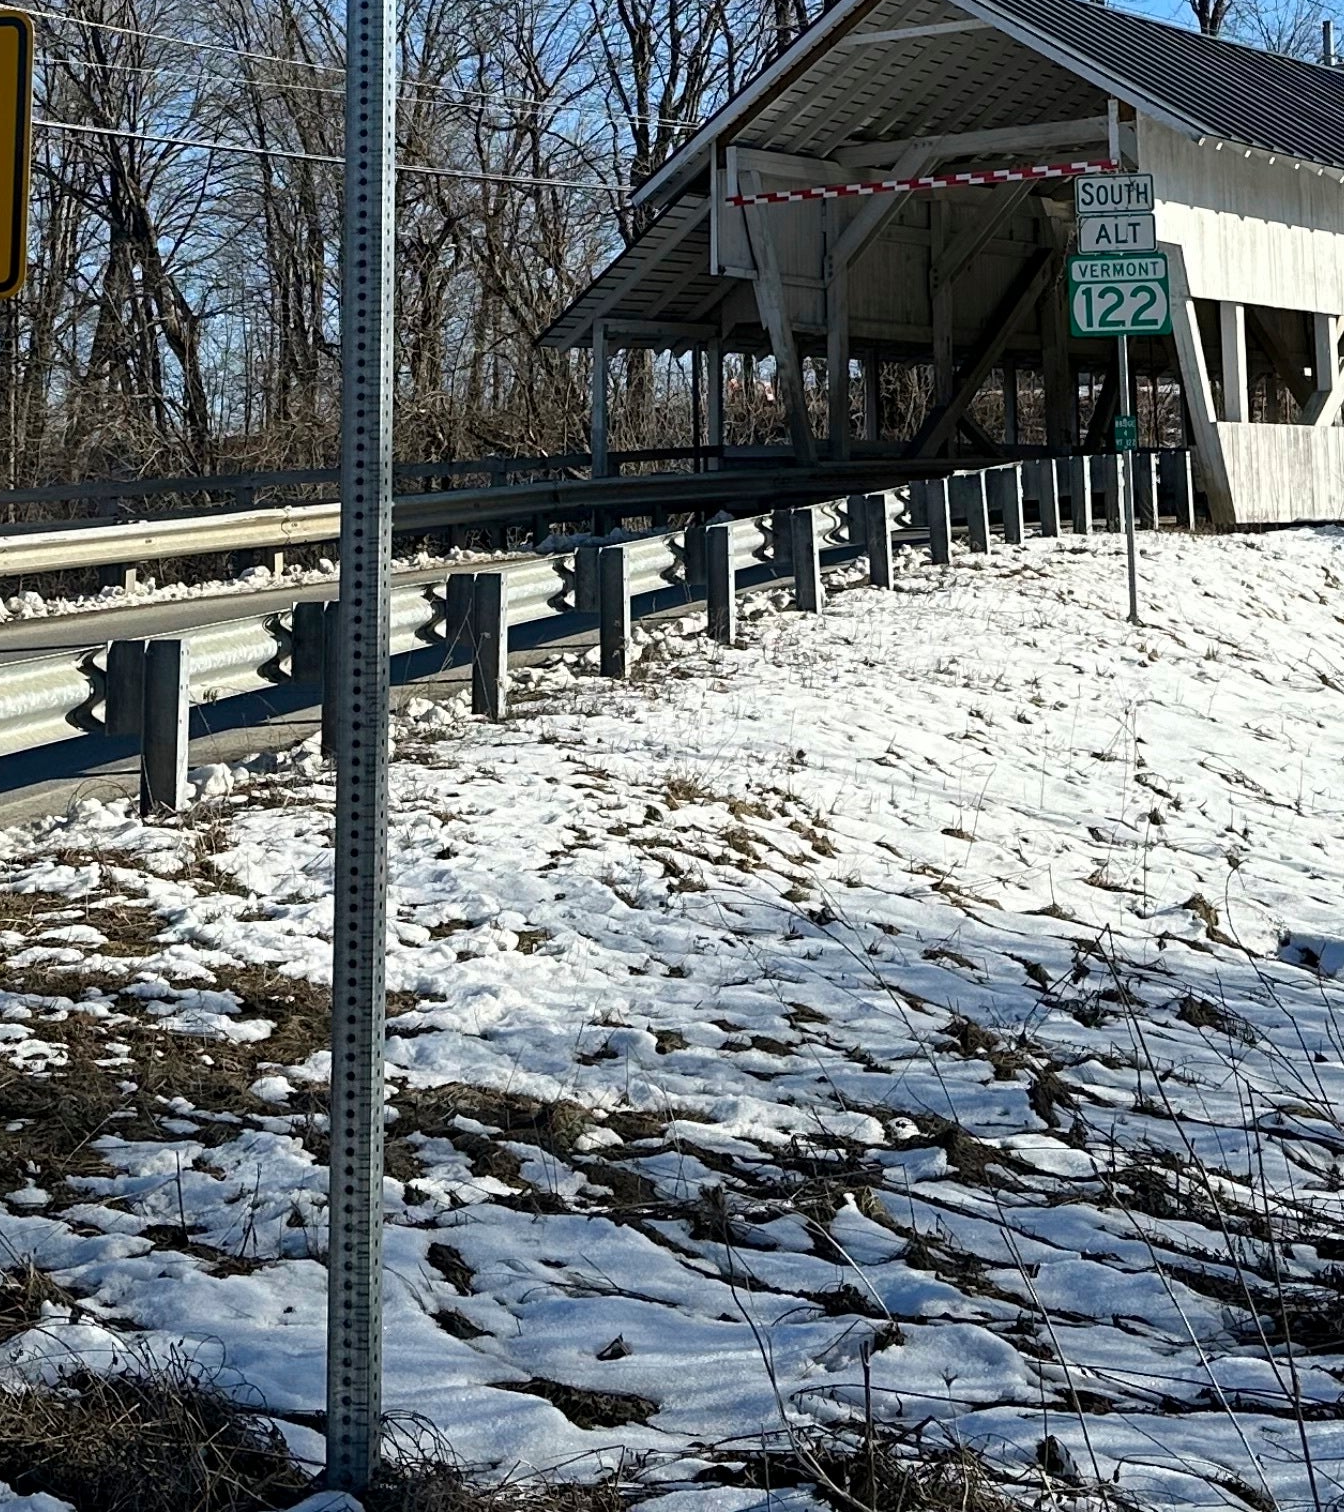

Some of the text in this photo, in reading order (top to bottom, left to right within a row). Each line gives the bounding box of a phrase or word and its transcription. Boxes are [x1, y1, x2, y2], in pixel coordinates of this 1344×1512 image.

[1081, 182, 1148, 206] SOUTH
[1095, 222, 1141, 245] ALT
[1078, 261, 1159, 278] VERMONT
[1081, 285, 1158, 328] 122
